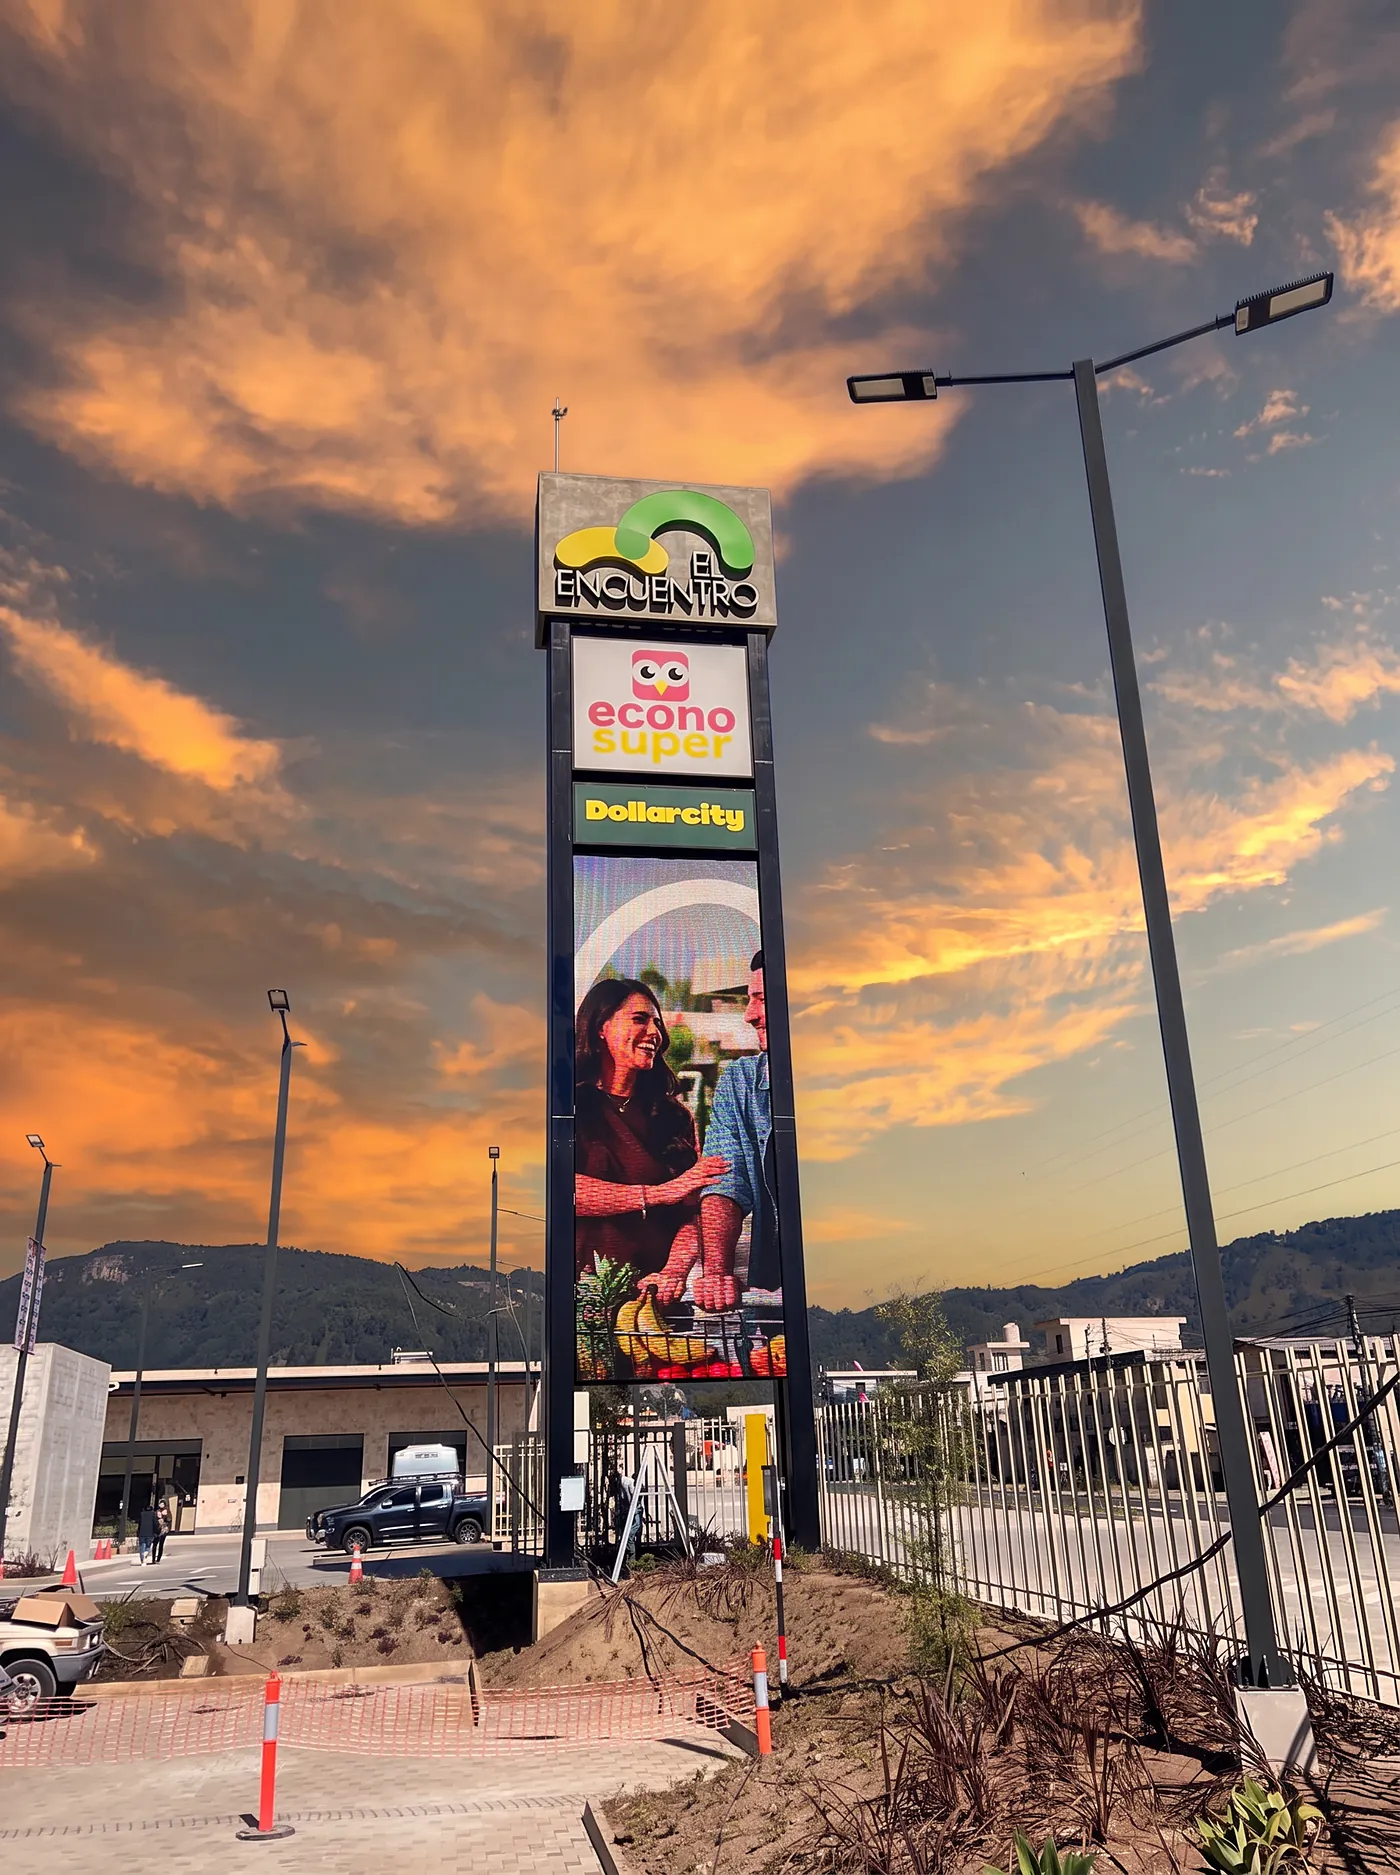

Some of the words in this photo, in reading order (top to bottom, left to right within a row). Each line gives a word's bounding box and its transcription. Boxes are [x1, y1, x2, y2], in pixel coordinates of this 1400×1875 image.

[691, 550, 725, 579] EL
[556, 569, 760, 608] ENCUENTRO
[588, 701, 736, 733] econo
[592, 728, 733, 764] super
[585, 799, 745, 832] Dollarcity
